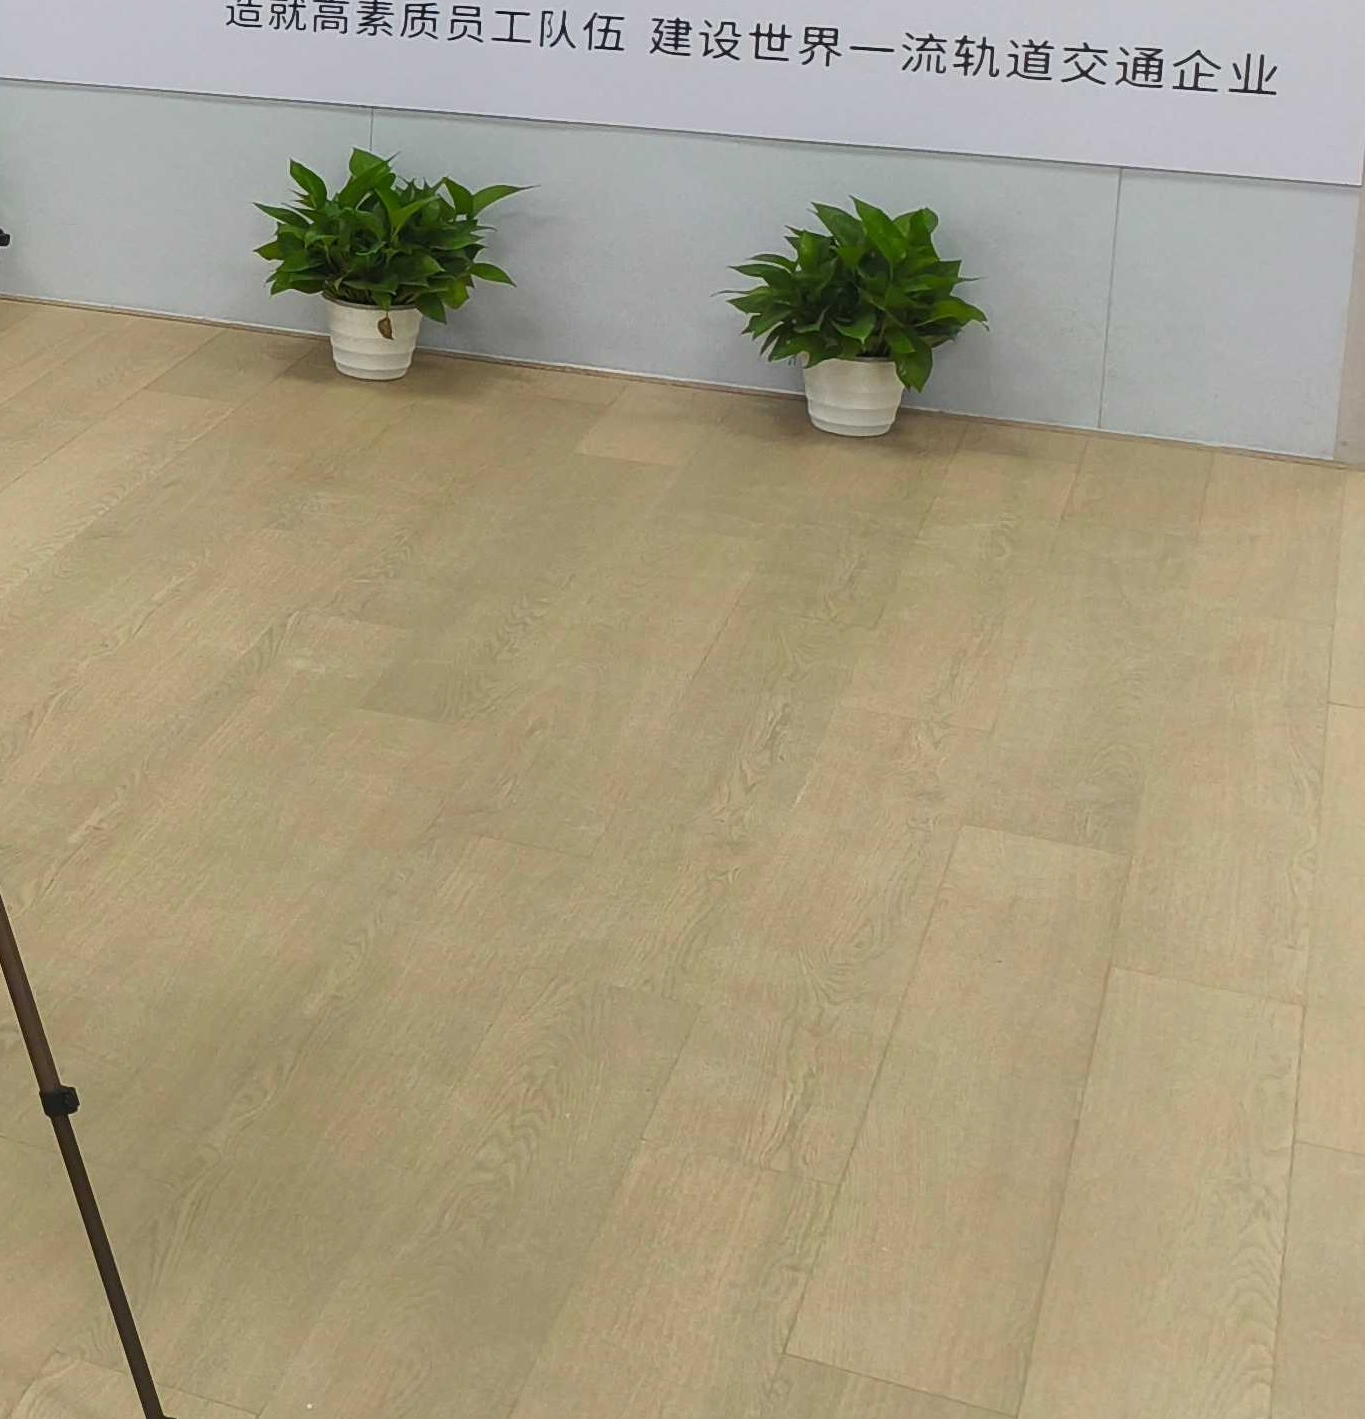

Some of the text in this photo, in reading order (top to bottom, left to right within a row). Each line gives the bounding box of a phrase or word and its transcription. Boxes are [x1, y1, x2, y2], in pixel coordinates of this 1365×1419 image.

[649, 16, 1278, 97] 建设世界一流轨道交通企业
